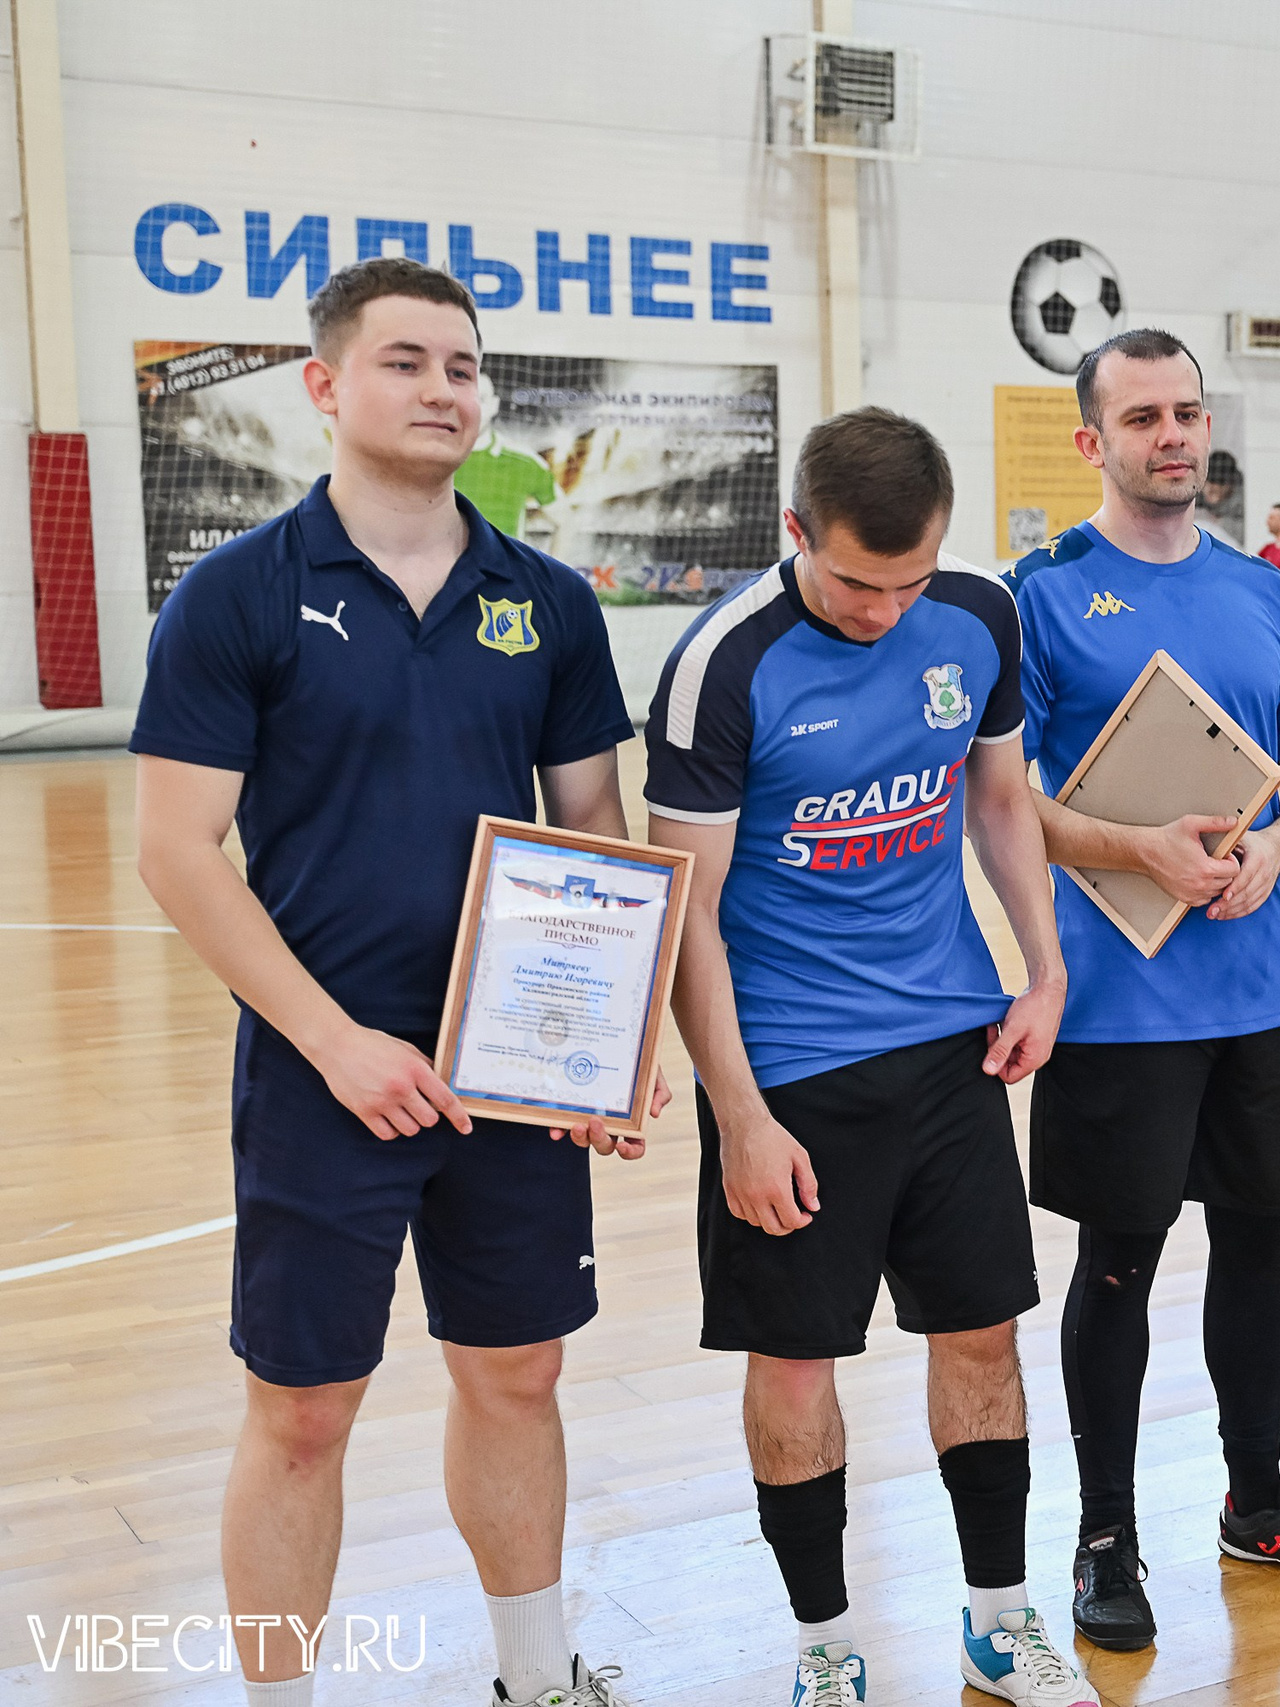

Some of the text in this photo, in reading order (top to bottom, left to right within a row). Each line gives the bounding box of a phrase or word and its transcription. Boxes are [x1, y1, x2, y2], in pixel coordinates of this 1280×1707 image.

[133, 202, 773, 324] СИЛЬНЕЕ
[807, 719, 839, 734] SPORT
[777, 806, 950, 871] SERVICE
[544, 929, 599, 946] ПИСЬМО
[513, 965, 615, 990] Дмитрию Игоревичу
